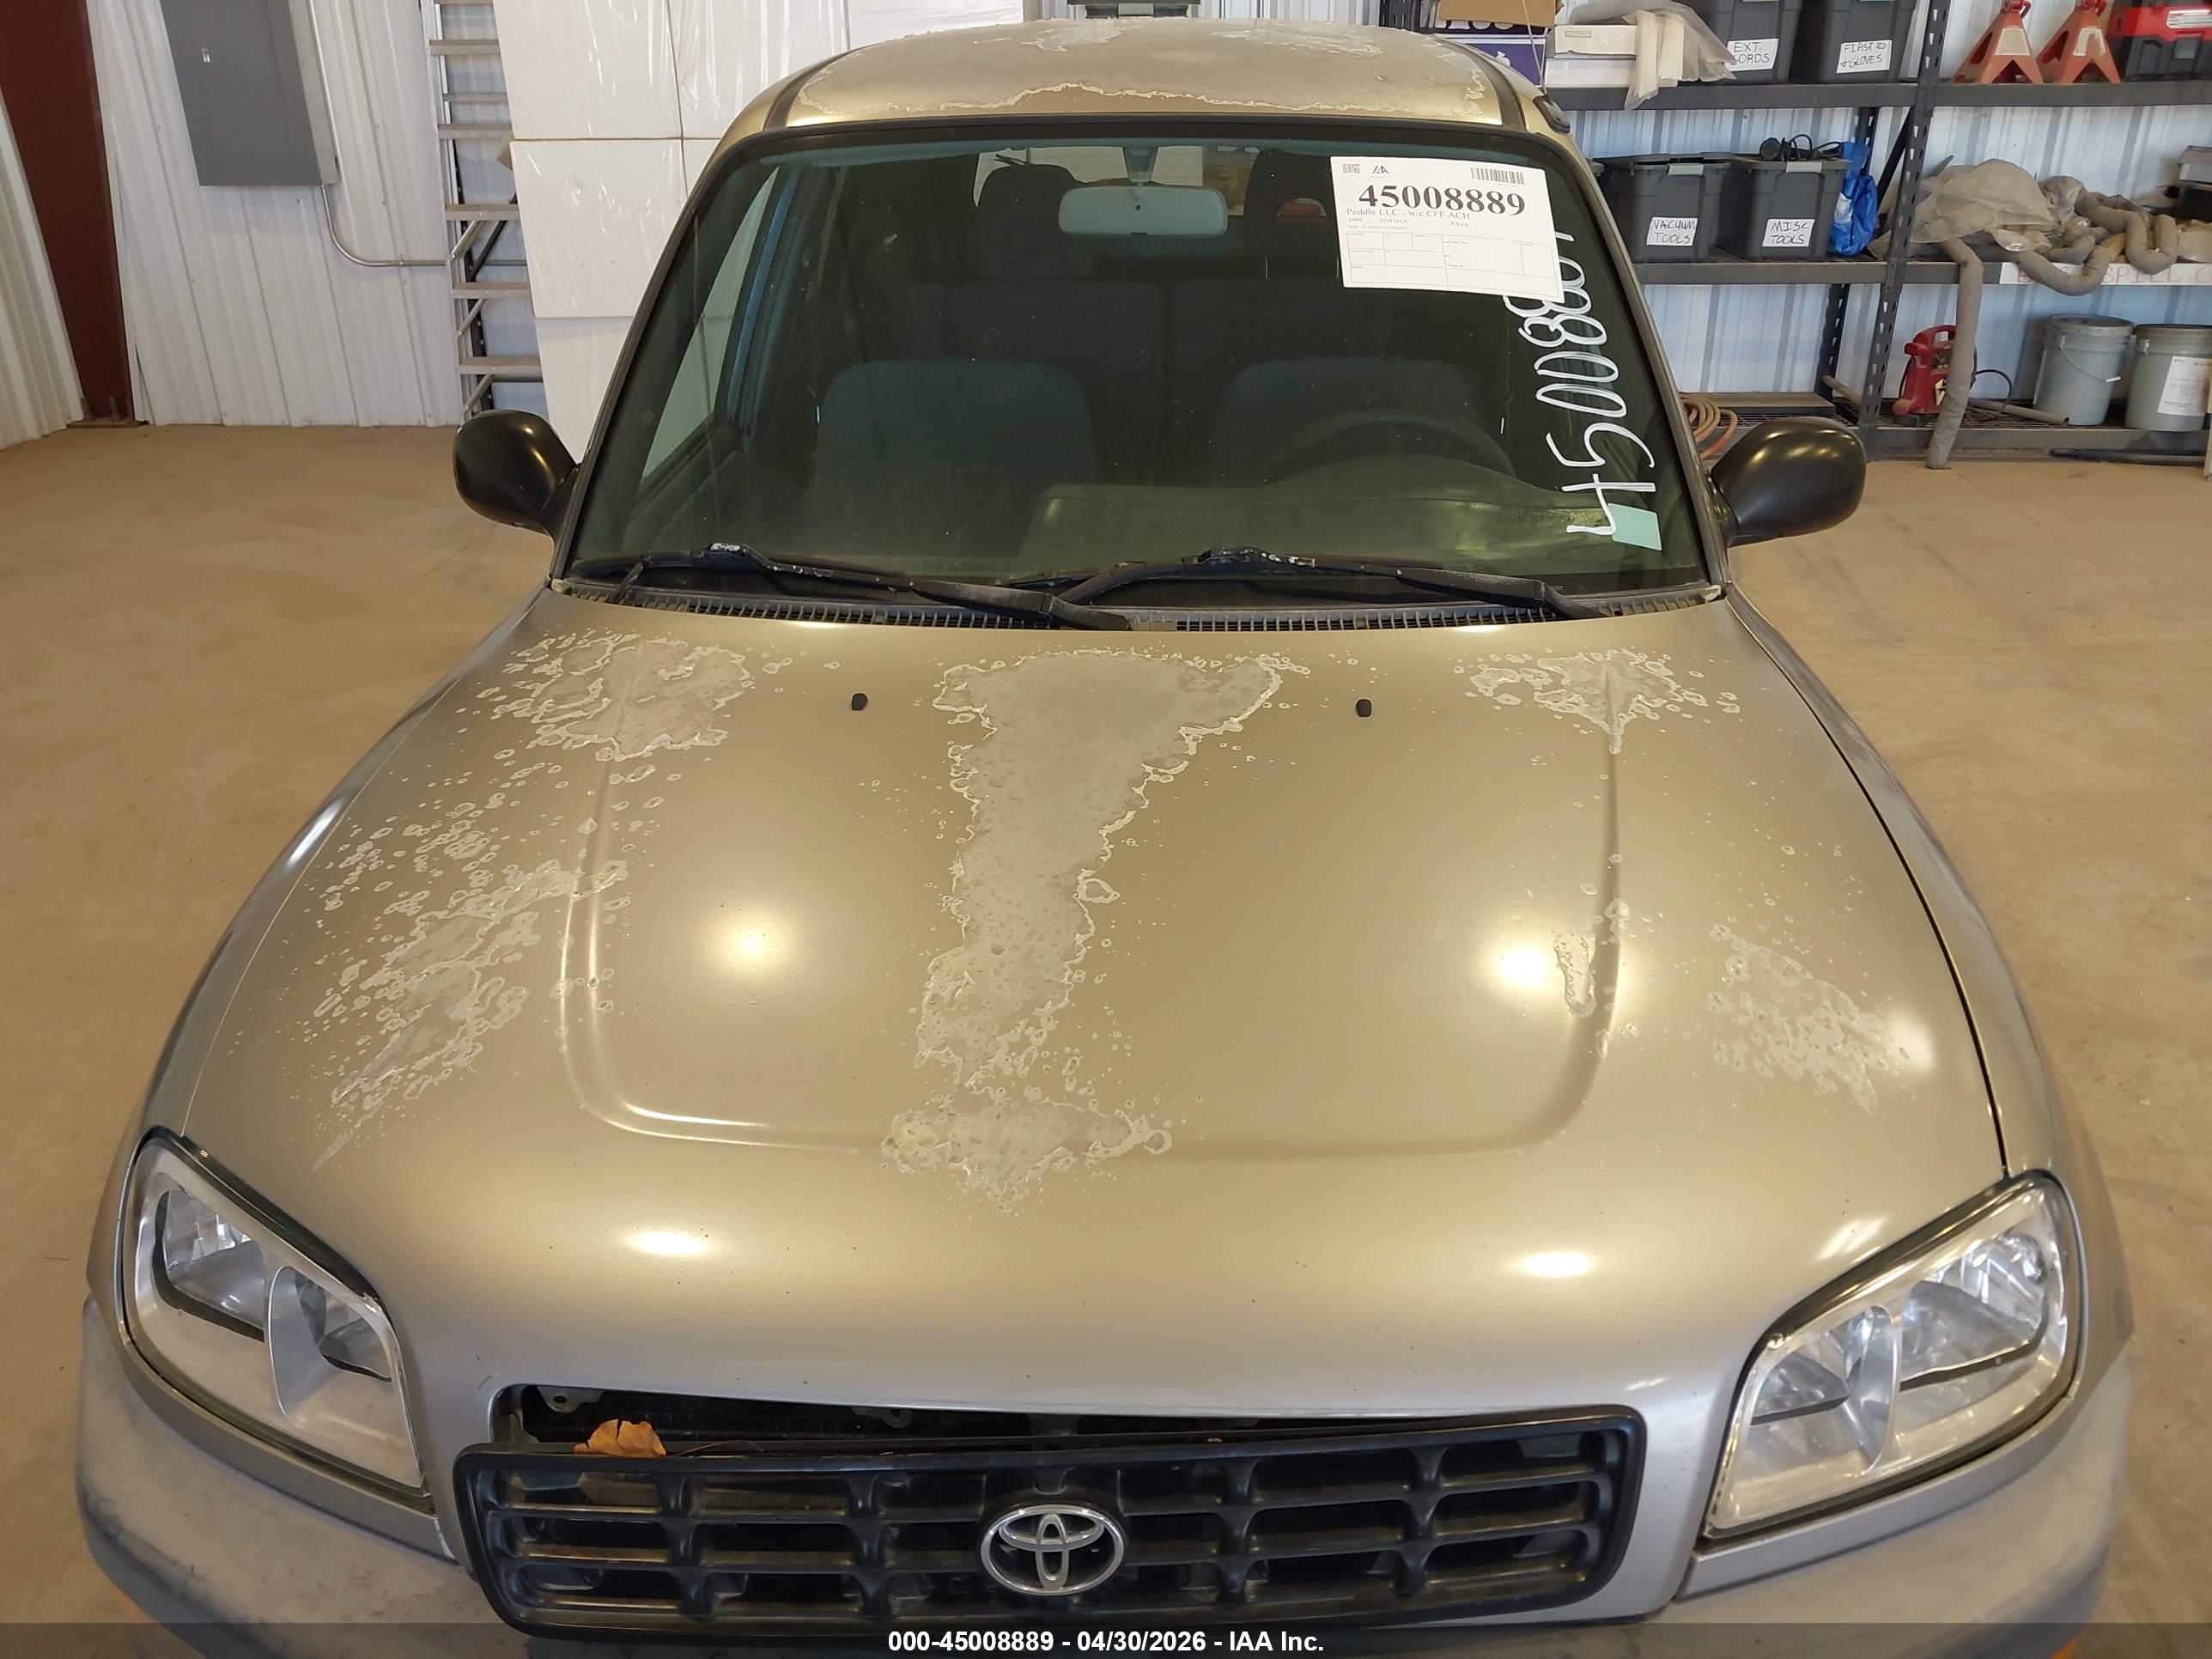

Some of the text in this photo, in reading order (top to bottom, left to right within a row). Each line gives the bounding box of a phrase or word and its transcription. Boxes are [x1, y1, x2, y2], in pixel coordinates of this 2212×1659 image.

[1734, 41, 1762, 52] EXT.
[1844, 42, 1874, 53] FIRST
[1733, 53, 1771, 64] ORDS
[1358, 185, 1526, 216] 45008889
[1448, 211, 1470, 220] ACH
[1652, 219, 1696, 231] VACUUM
[1770, 221, 1811, 233] MISC
[1654, 232, 1691, 244] TOOLS
[1770, 234, 1805, 245] TOOLS
